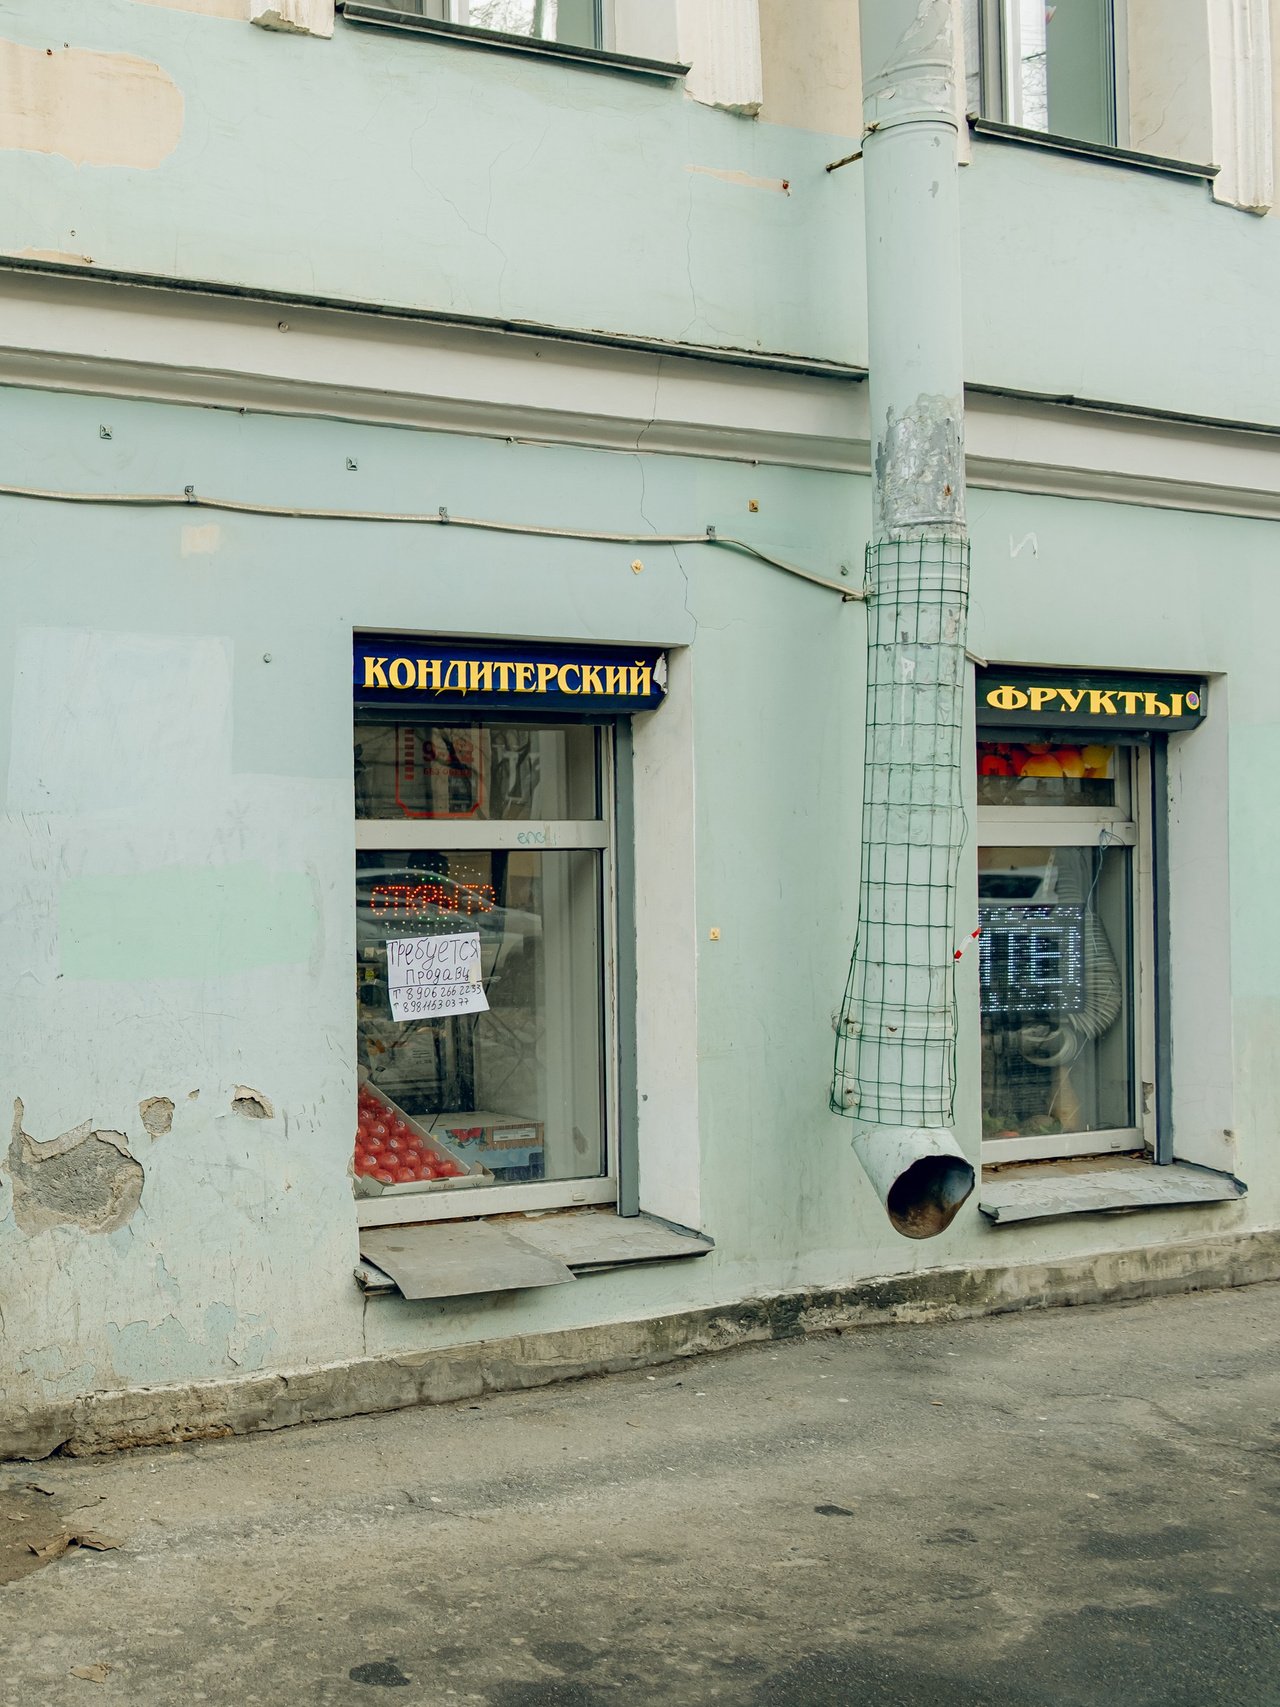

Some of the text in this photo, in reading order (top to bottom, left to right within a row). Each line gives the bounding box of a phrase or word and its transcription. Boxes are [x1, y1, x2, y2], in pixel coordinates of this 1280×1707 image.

[362, 656, 653, 697] КОНДИТЕРСКИЙ
[986, 685, 1184, 717] ФРУКТЫ
[370, 884, 496, 917] ОТКРЫТО
